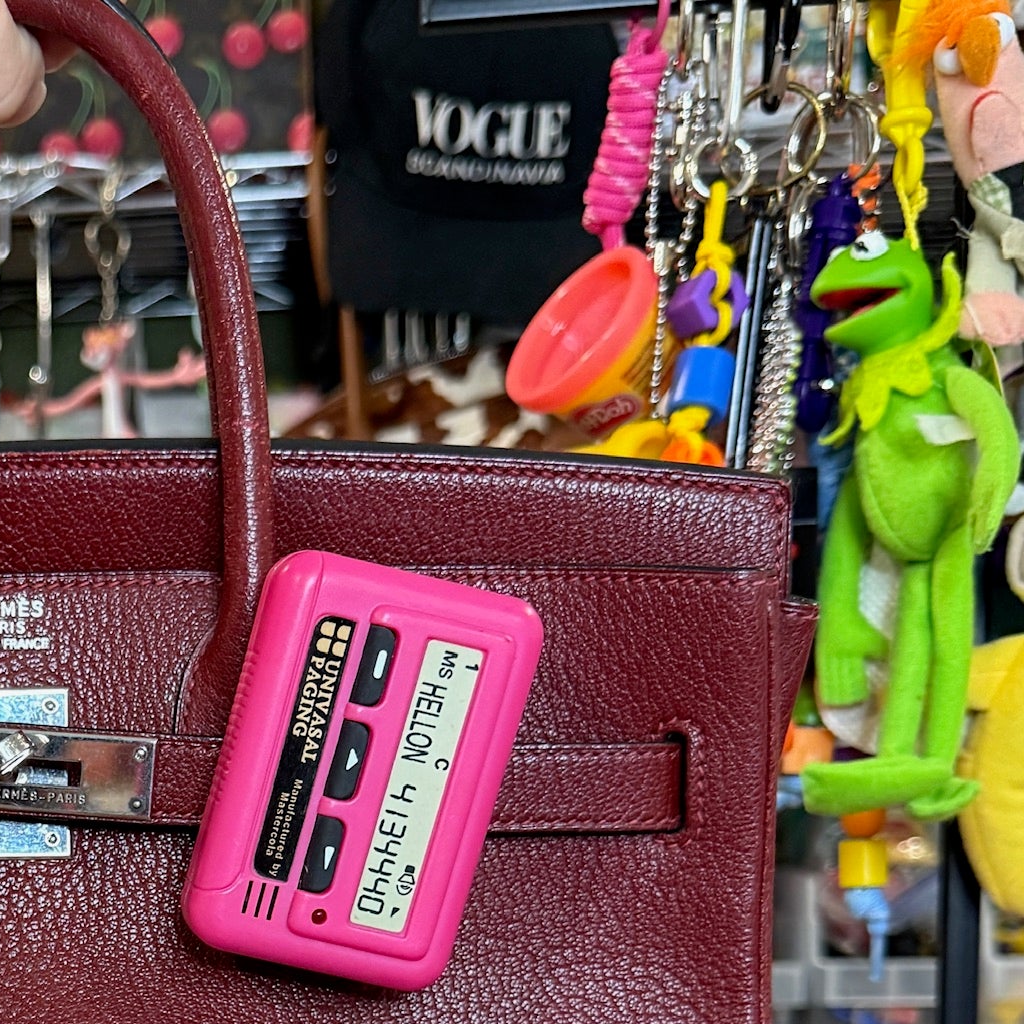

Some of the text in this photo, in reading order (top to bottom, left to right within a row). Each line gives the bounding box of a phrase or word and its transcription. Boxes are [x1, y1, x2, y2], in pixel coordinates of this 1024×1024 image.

[413, 89, 572, 158] VOGUE
[3, 637, 51, 651] FRANCE
[438, 650, 458, 680] MS
[293, 656, 326, 738] PAGING
[301, 660, 341, 764] UNIVASAL
[401, 682, 448, 764] HELLON
[435, 758, 450, 771] C
[268, 779, 303, 877] Manufactured by
